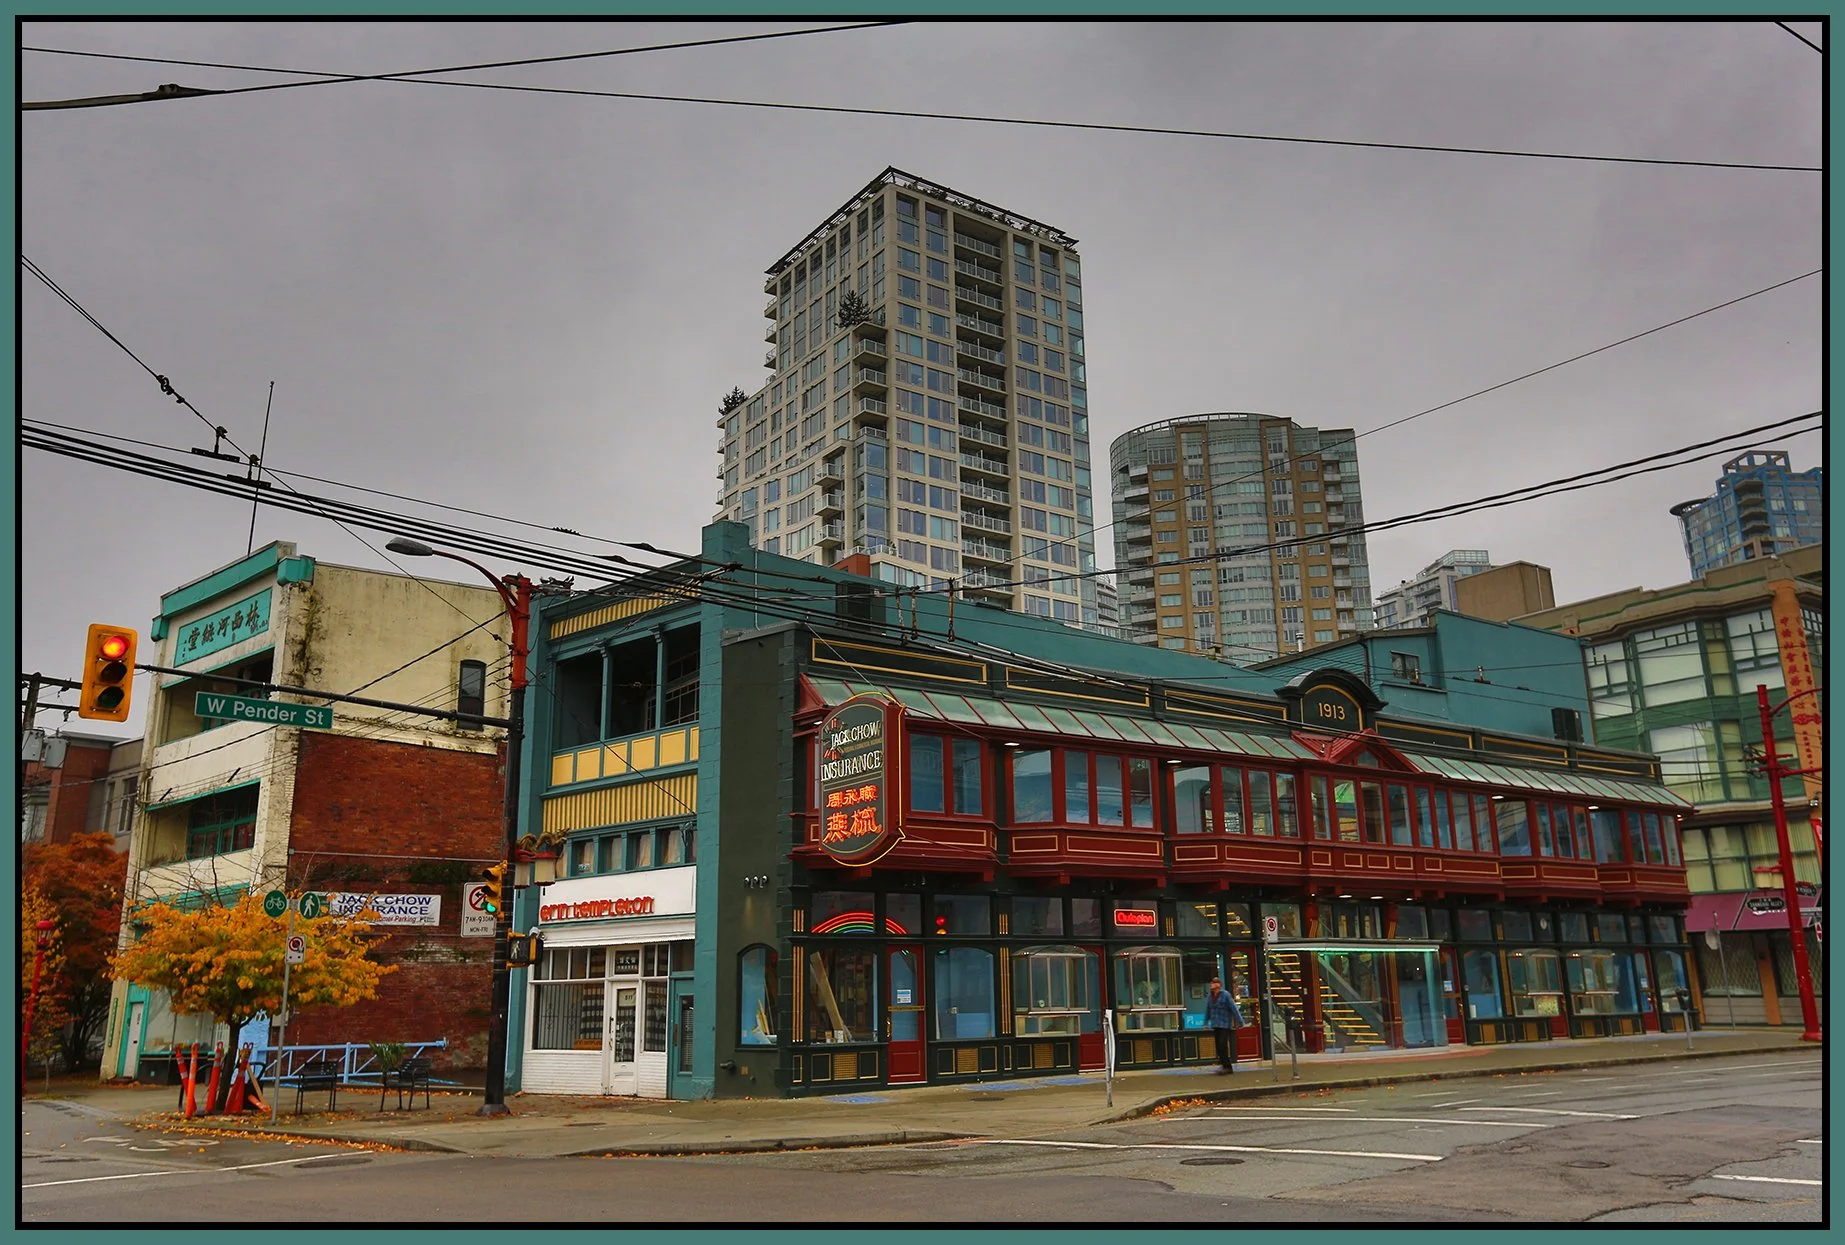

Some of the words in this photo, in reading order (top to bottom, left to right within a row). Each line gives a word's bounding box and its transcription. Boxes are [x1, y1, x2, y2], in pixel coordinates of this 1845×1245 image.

[207, 698, 226, 714] W
[233, 701, 297, 721] Pender
[305, 709, 324, 725] St
[1319, 702, 1346, 720] 1913
[831, 728, 853, 750] JACK
[851, 720, 881, 741] CHOW
[821, 750, 883, 781] INSURANCE
[384, 896, 432, 905] CHOW
